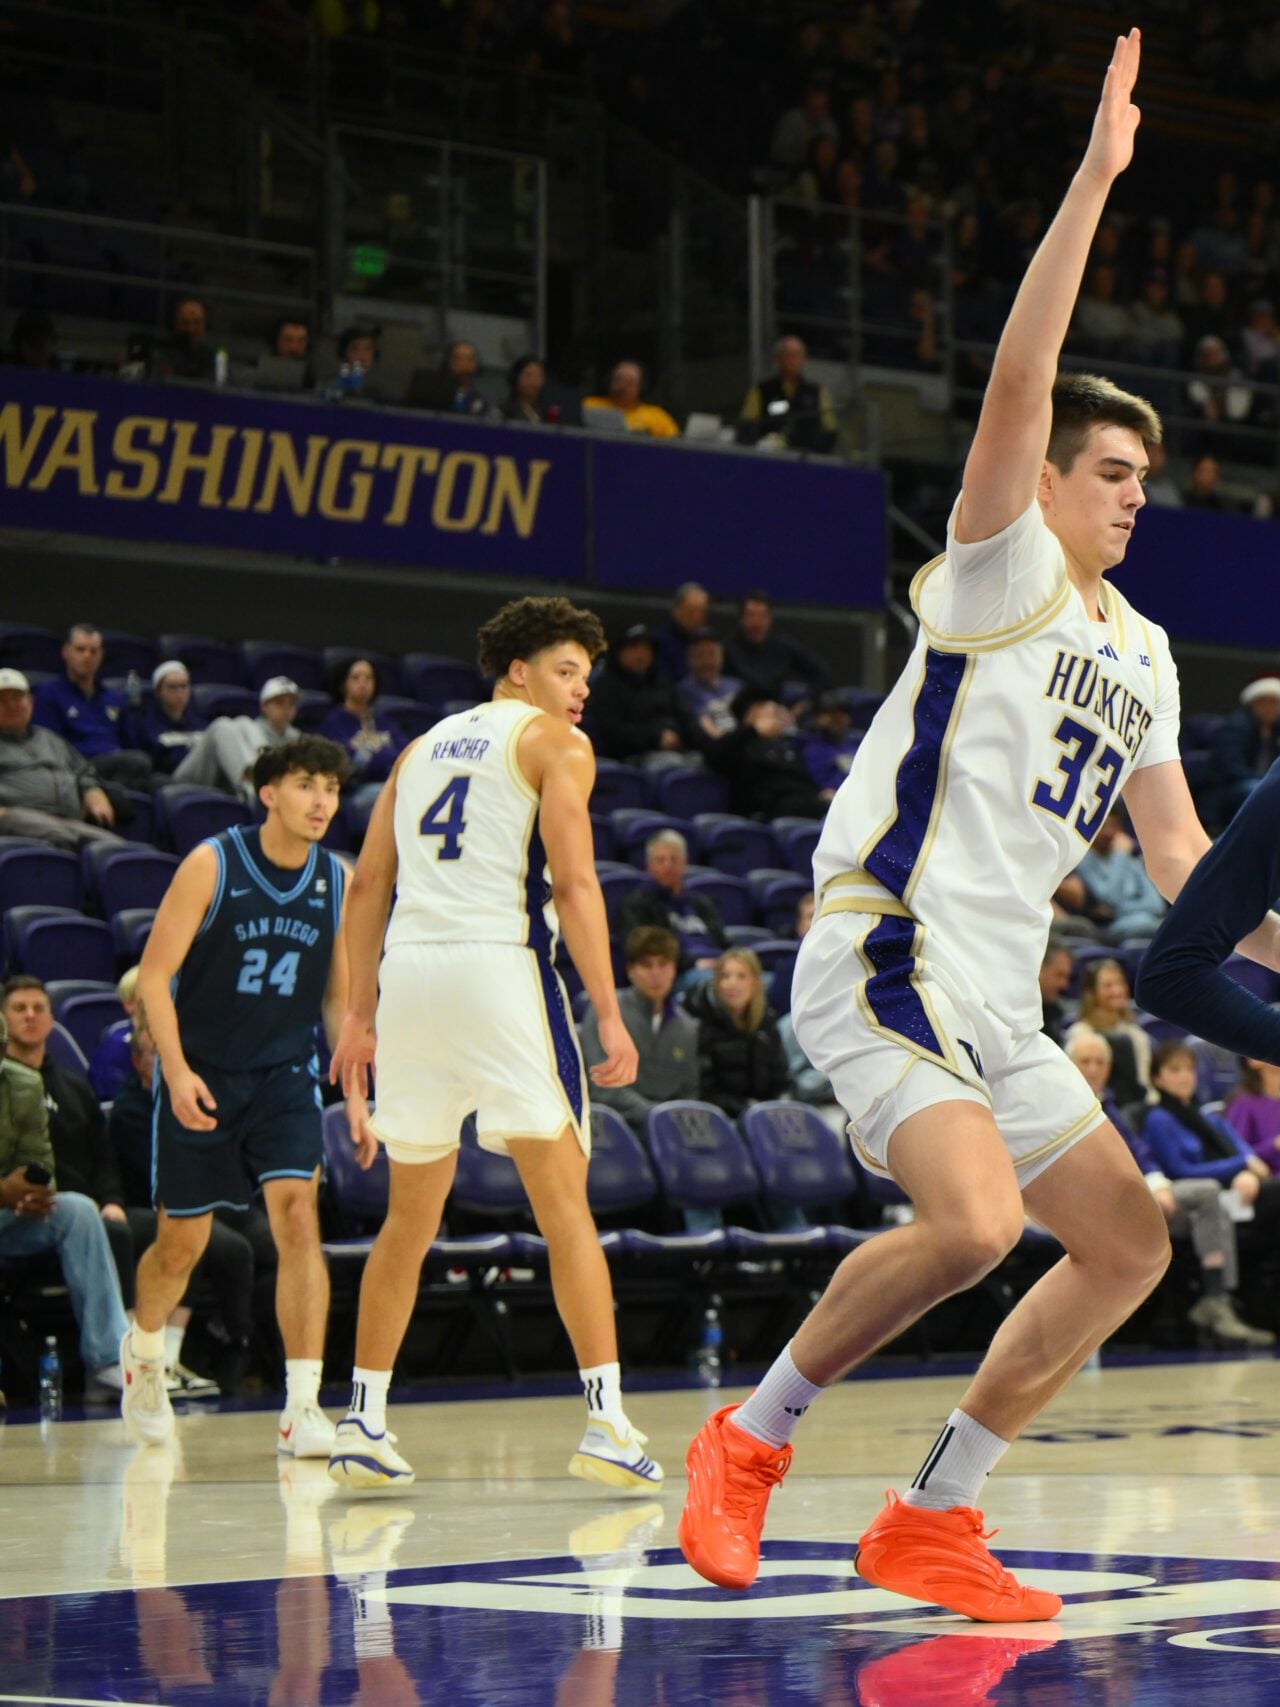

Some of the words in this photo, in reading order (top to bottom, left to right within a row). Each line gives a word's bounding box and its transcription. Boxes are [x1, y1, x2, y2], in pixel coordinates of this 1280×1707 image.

[0, 402, 551, 539] WASHINGTON
[431, 737, 490, 761] RENCHER
[1044, 649, 1153, 762] HUKIES
[417, 772, 470, 862] 4
[1029, 712, 1126, 843] 33
[235, 917, 269, 942] SAN
[274, 916, 320, 947] DIEGO
[236, 948, 301, 997] 24
